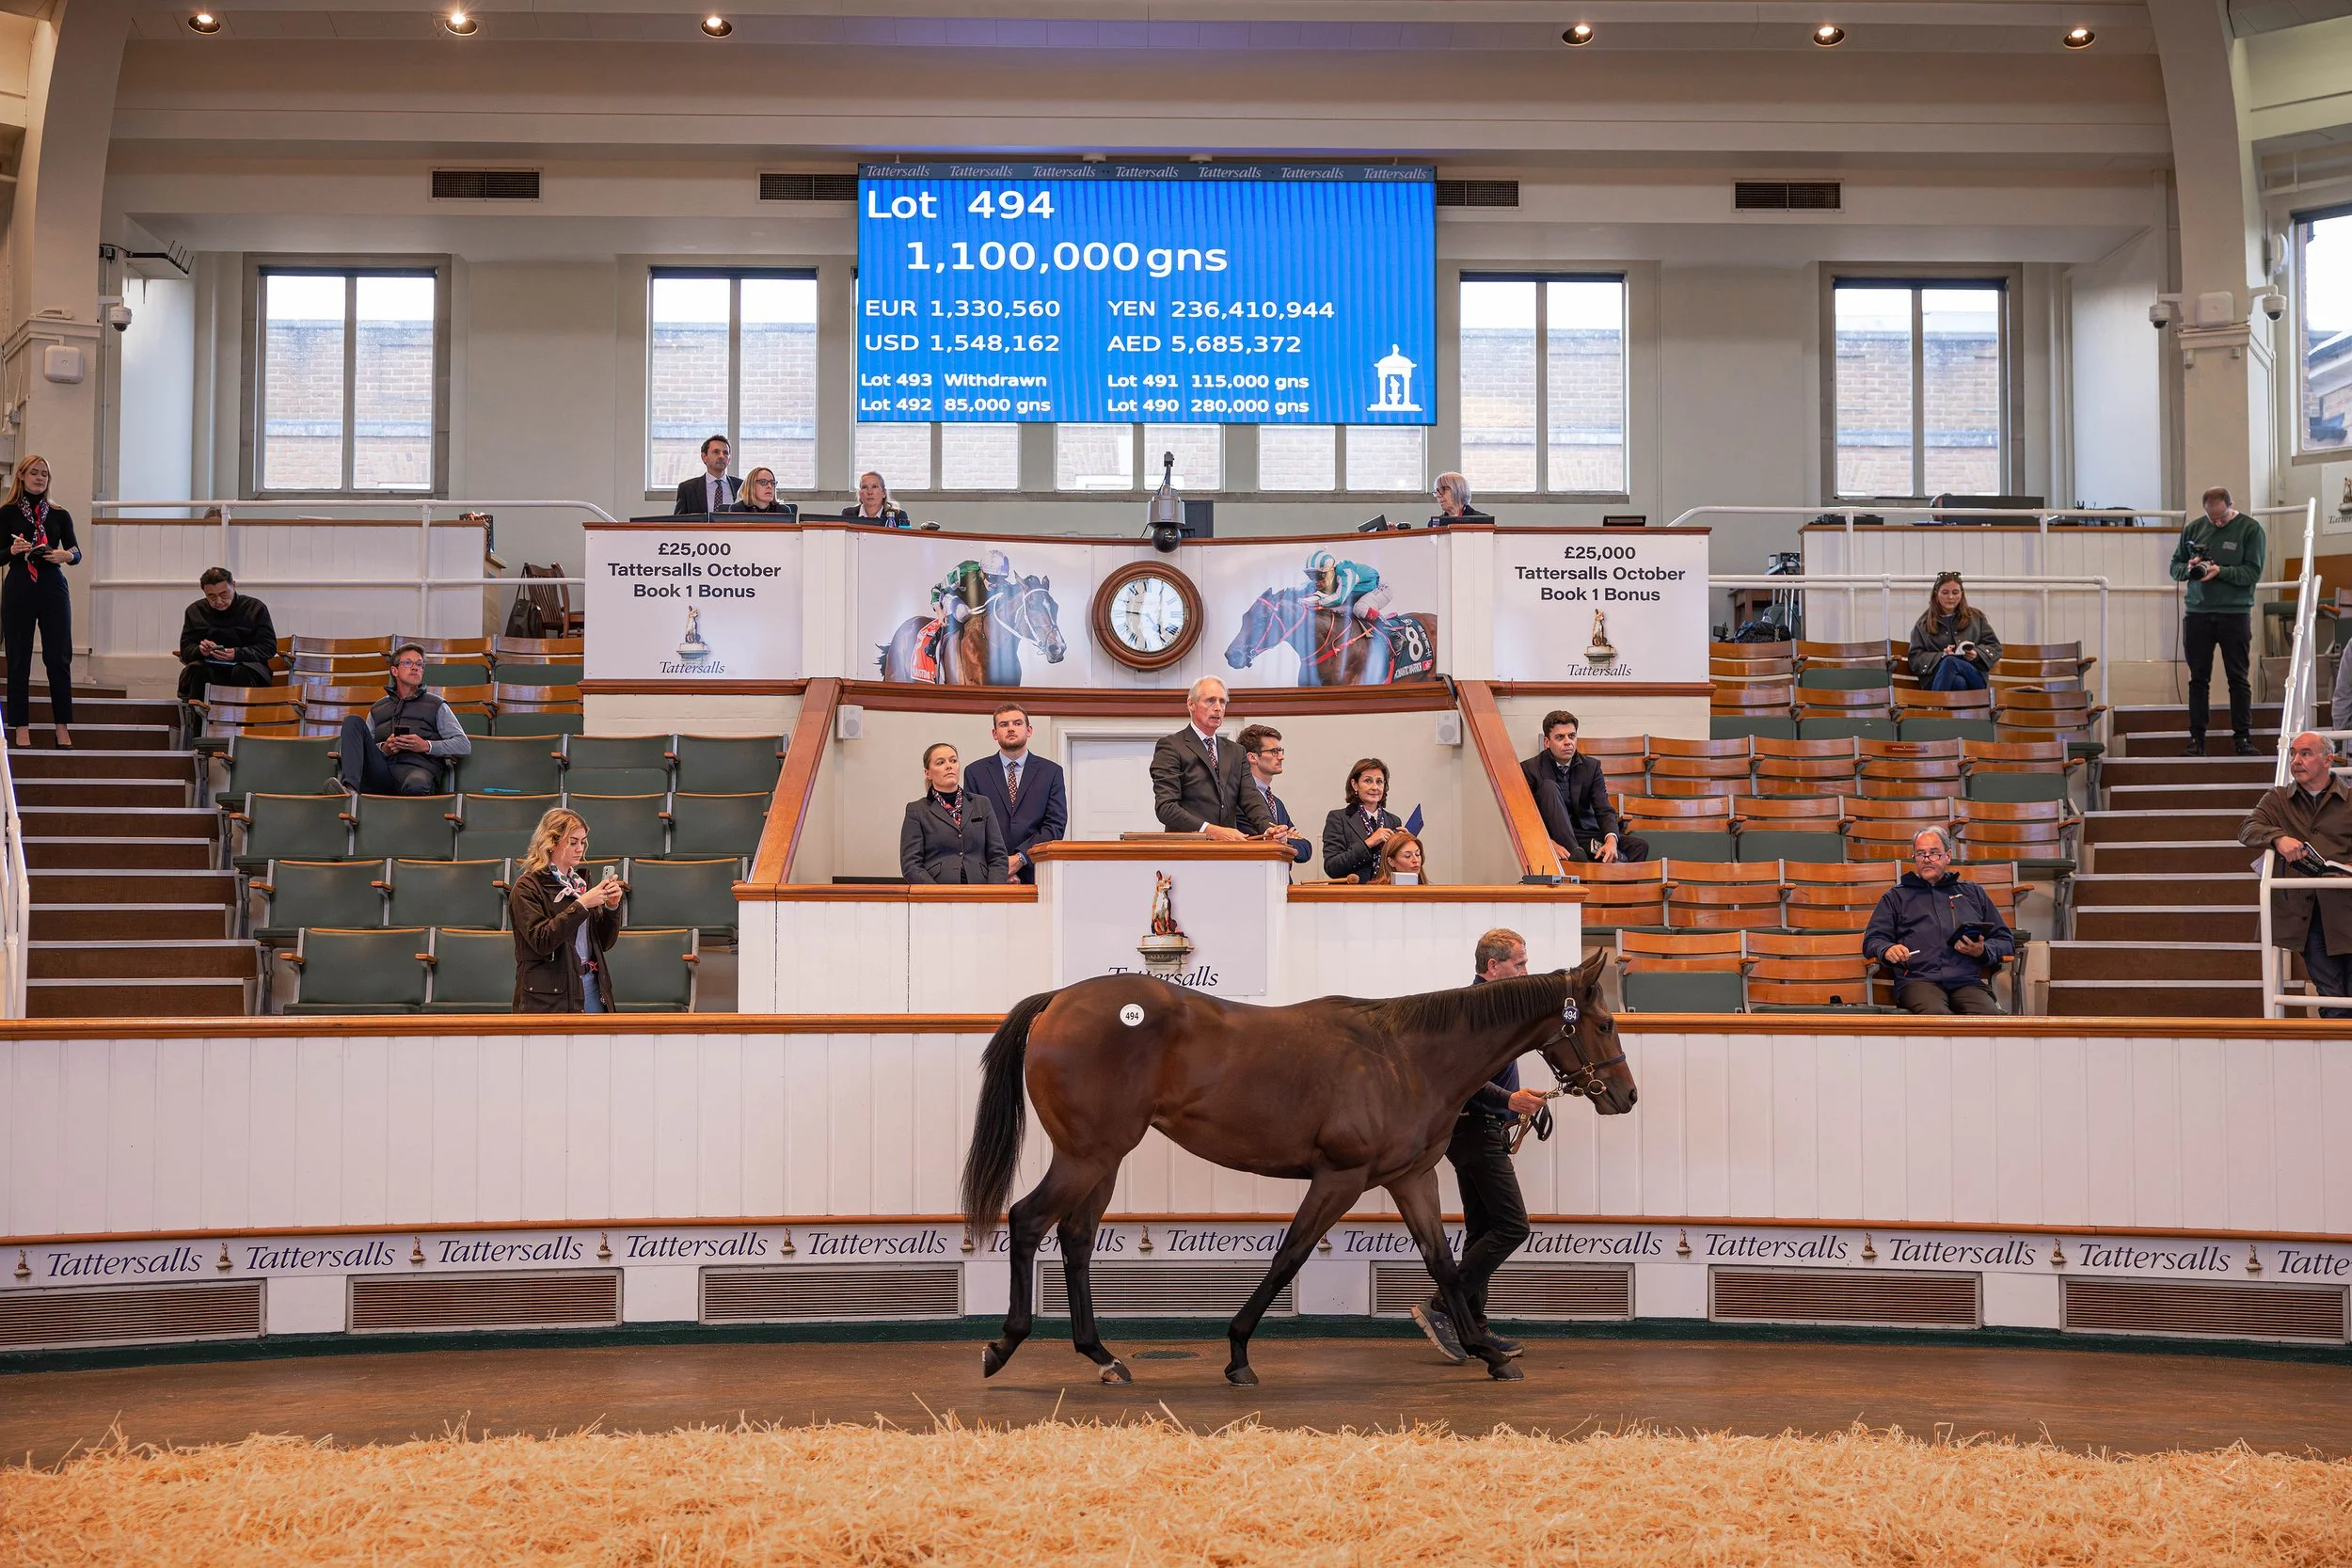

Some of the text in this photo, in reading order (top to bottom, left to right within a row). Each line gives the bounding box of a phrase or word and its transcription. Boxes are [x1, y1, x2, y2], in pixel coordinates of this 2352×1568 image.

[867, 166, 1426, 179] Tattersalls Tattersalls Tattersalls Tattersalls Tattersalls Tattersalls Tattersalls
[868, 191, 1055, 219] Lot 494
[908, 242, 1227, 277] 1,100,000 gns
[866, 300, 1059, 318] EUR 1,330,560
[1108, 301, 1334, 320] YEN 236,410,944
[866, 335, 1058, 353] USD 1,548,162
[1107, 336, 1300, 354] AED 5,685,372
[862, 373, 1046, 387] Lot 493 Withdrawn
[1108, 374, 1309, 390] Lot 491 115,000 gns
[862, 399, 1051, 414] Lot 492 85,000 gns
[1108, 399, 1309, 415] Lot 490 280,000 gns
[659, 543, 730, 557] £25,000
[1565, 546, 1635, 561] £25,000
[608, 562, 781, 577] Tattersalls October
[1515, 566, 1685, 580] Tattersalls October
[634, 584, 755, 597] Book 1 Bonus
[1542, 587, 1660, 601] Book 1 Bonus
[1405, 626, 1423, 661] 8
[660, 660, 724, 673] Tattersalls
[1567, 663, 1632, 676] Tattersalls
[1125, 1011, 1139, 1021] 494
[1564, 1010, 1578, 1021] 494
[47, 1246, 202, 1277] Tattersalls
[246, 1242, 395, 1270] Tattersalls
[438, 1235, 583, 1263] Tattersalls
[627, 1231, 768, 1259] Tattersalls
[808, 1230, 946, 1254] Tattersalls
[1523, 1230, 1662, 1255] Tattersalls
[1706, 1234, 1848, 1261] Tattersalls
[1889, 1239, 2036, 1266] Tattersalls
[2080, 1243, 2231, 1272] Tattersalls
[2278, 1250, 2352, 1275] Tatte
